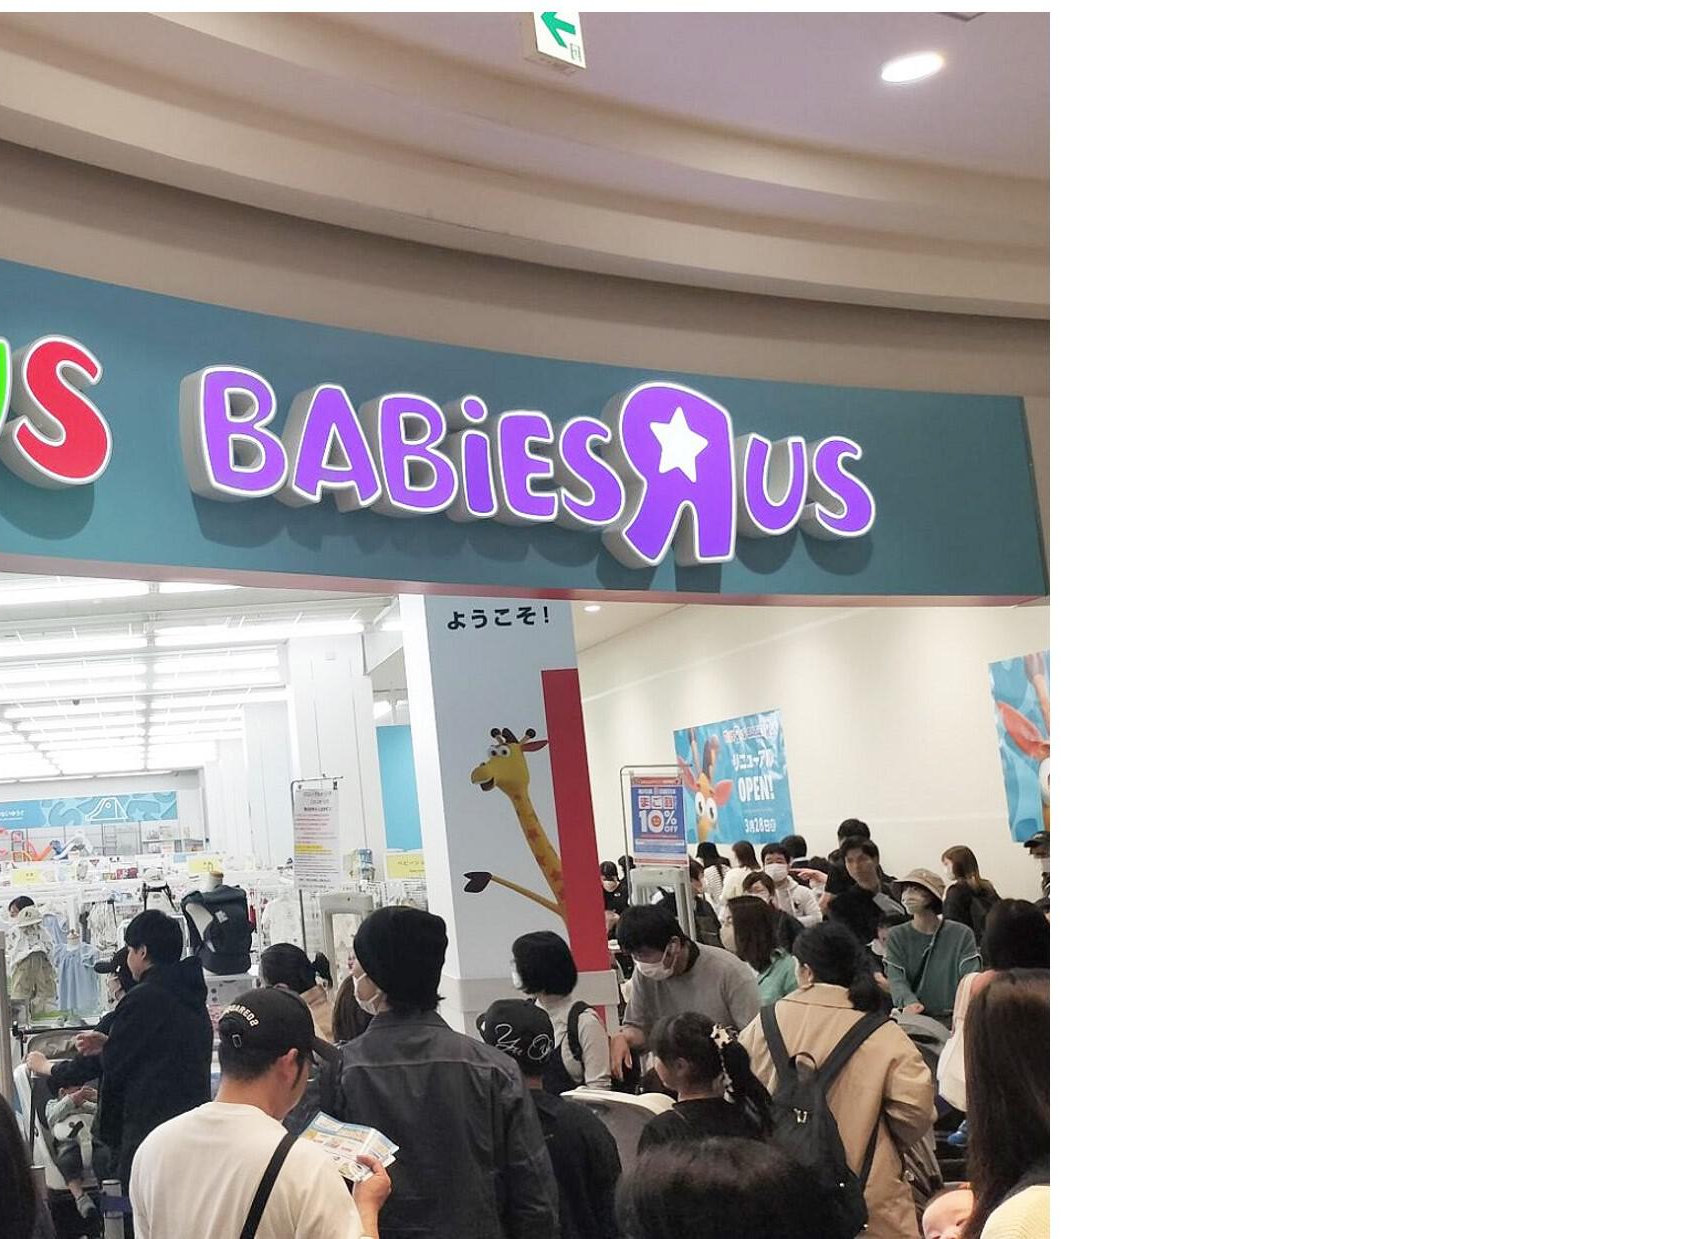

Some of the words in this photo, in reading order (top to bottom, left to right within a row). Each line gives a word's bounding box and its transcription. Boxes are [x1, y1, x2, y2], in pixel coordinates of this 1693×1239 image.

[732, 749, 775, 772] リニューアル
[738, 775, 775, 802] OPEN!
